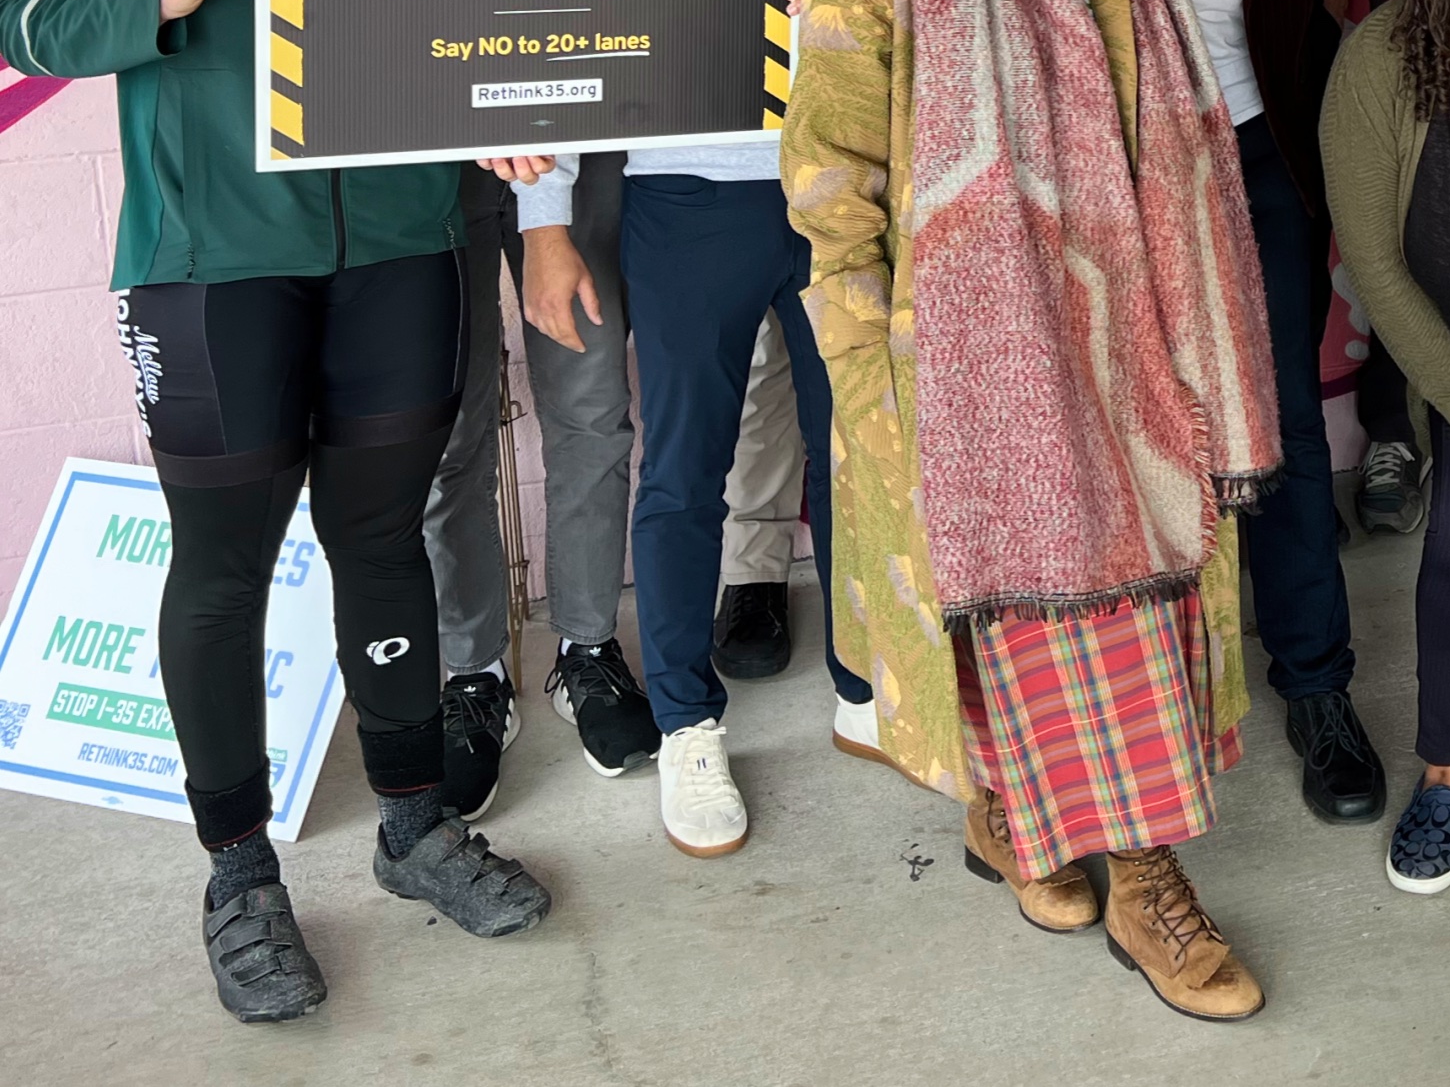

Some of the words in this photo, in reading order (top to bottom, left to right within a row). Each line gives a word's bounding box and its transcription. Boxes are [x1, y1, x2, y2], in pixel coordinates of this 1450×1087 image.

[430, 36, 474, 62] Say
[479, 35, 513, 57] NO
[517, 35, 541, 55] to
[545, 33, 589, 54] 20+
[594, 31, 651, 52] lanes
[477, 81, 598, 102] Rethink35.org
[96, 514, 173, 568] MOR
[42, 615, 146, 674] MORE
[52, 689, 95, 718] STOP
[100, 694, 135, 726] I-35
[77, 742, 179, 778] RETHINK35.COM
